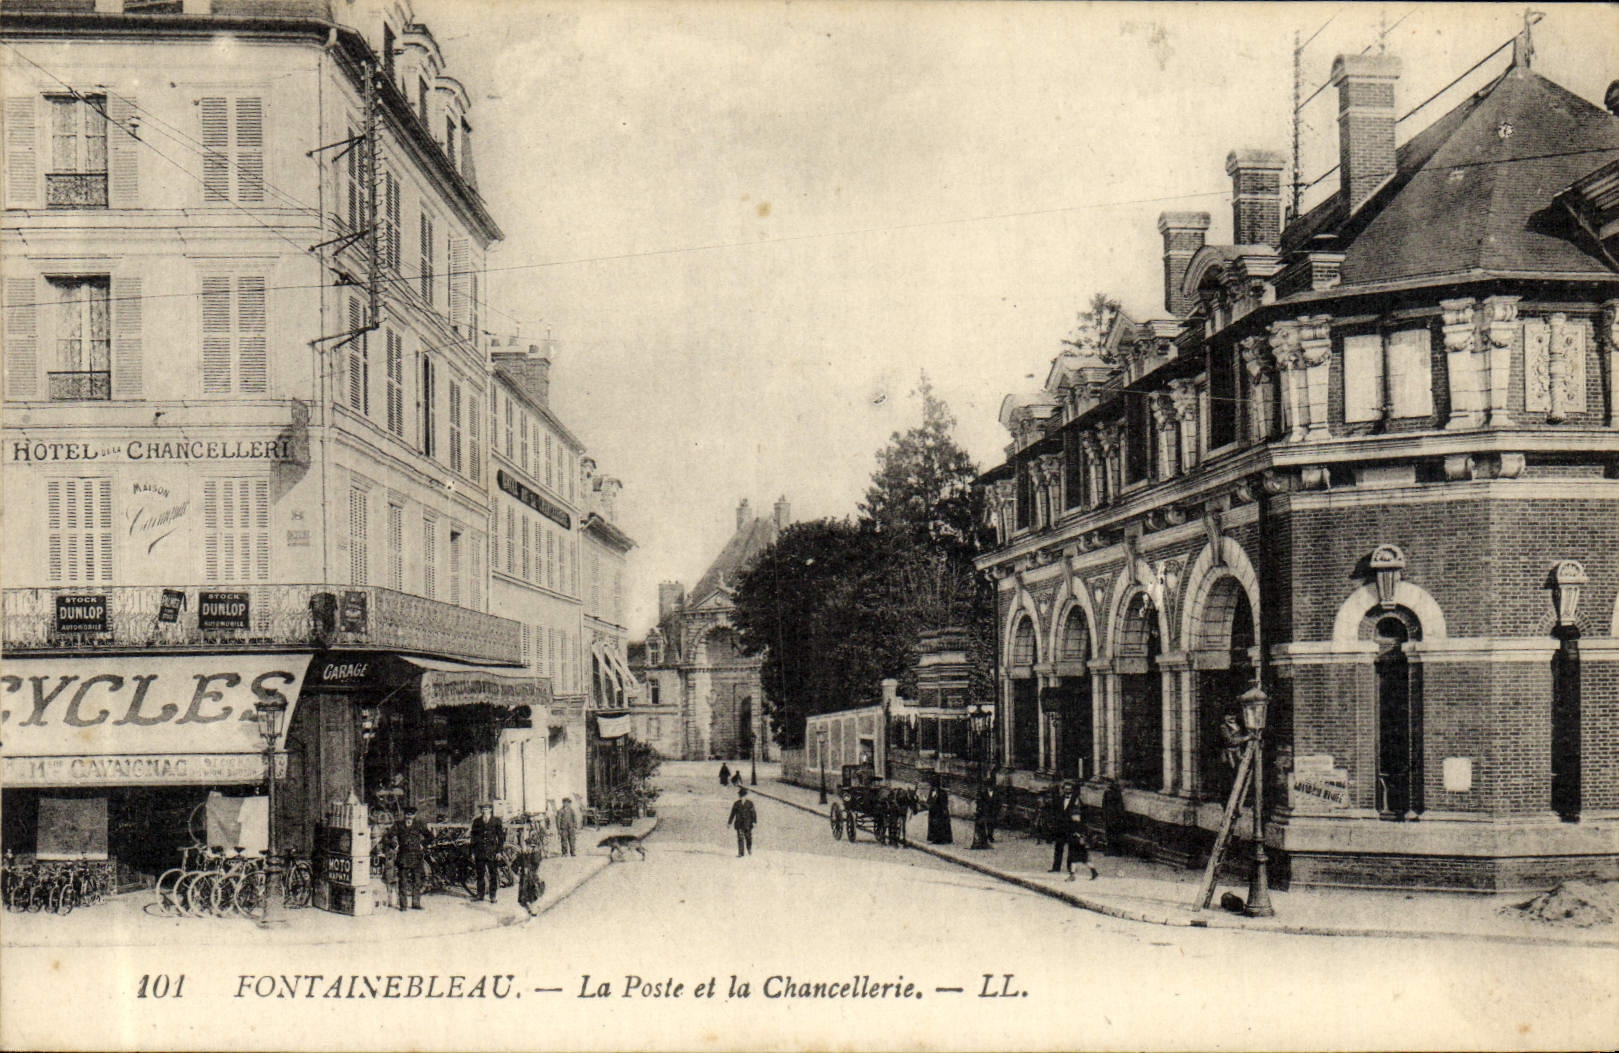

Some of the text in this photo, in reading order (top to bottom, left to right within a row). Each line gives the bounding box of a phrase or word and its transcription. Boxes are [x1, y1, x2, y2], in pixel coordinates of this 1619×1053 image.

[59, 606, 104, 619] DUNLOP
[202, 603, 246, 616] DUNLOP
[323, 663, 369, 681] GARAGE
[328, 858, 351, 873] MOTO
